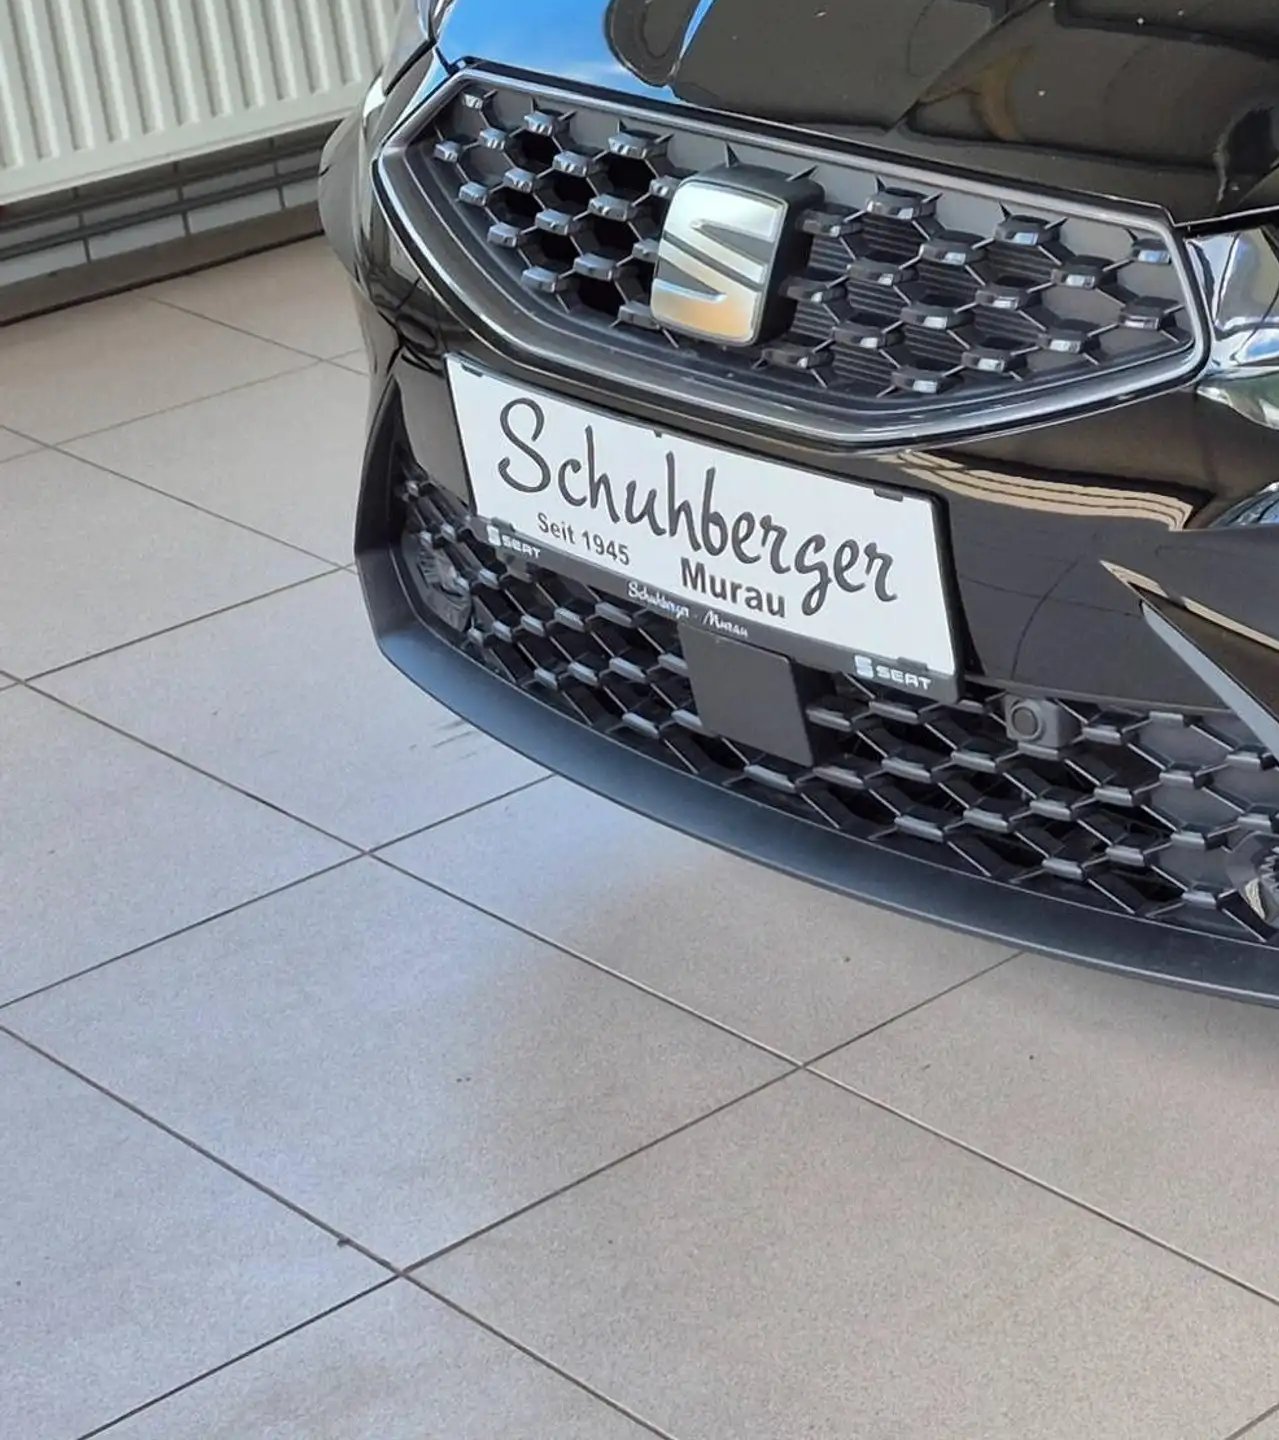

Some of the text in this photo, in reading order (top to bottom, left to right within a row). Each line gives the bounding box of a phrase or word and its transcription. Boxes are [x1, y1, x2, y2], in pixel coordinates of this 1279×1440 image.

[498, 397, 897, 616] Schuhberger
[501, 534, 541, 560] SEAT
[537, 512, 630, 566] Seit 1945
[680, 556, 786, 619] Murau
[875, 664, 932, 690] SEAT
